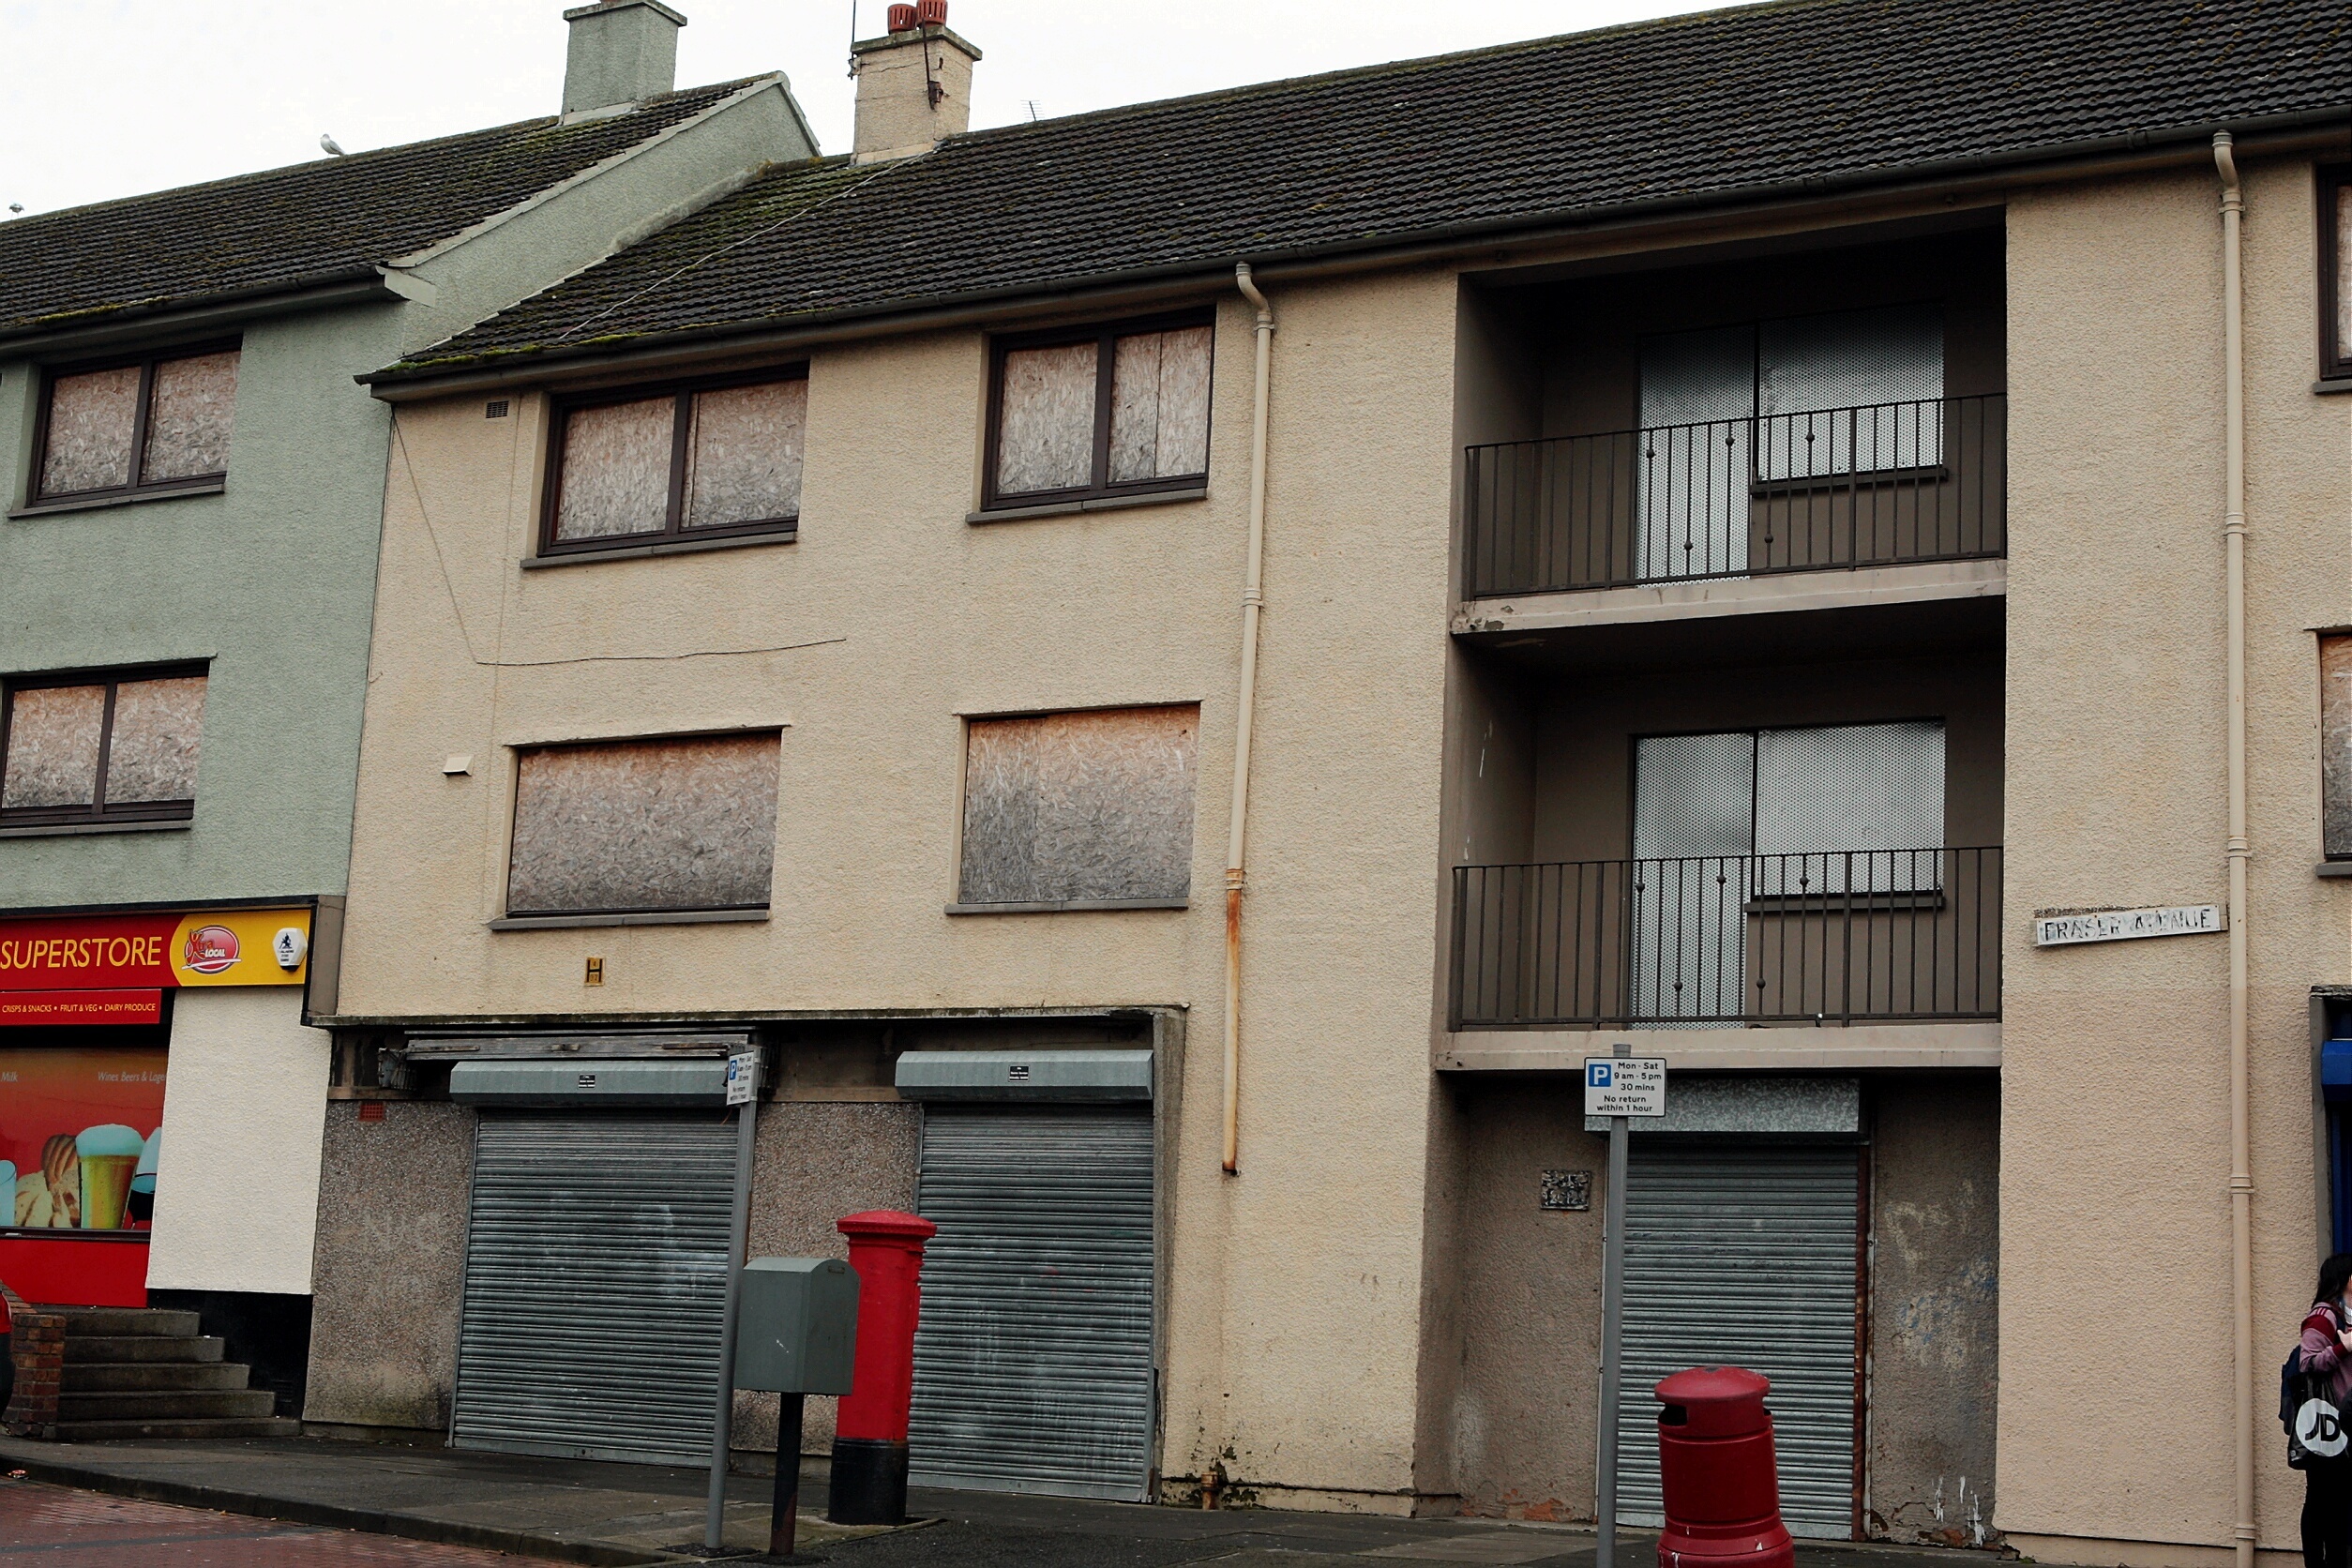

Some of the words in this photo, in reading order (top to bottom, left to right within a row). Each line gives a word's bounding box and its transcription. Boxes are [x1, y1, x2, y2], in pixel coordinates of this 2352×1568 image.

[2044, 915, 2121, 941] FRASER
[0, 936, 162, 970] SUPERSTORE
[205, 948, 226, 957] LOCAL
[2, 1004, 22, 1013] CRISPS
[23, 1004, 27, 1013] &
[28, 1004, 53, 1013] SNACKS
[85, 1003, 98, 1012] VEG
[104, 1003, 124, 1012] DAIRY
[1, 1071, 18, 1082] Milk
[98, 1072, 118, 1081] Wines
[120, 1071, 140, 1081] Beers
[1594, 1066, 1608, 1085] P
[2305, 1411, 2341, 1442] JD
